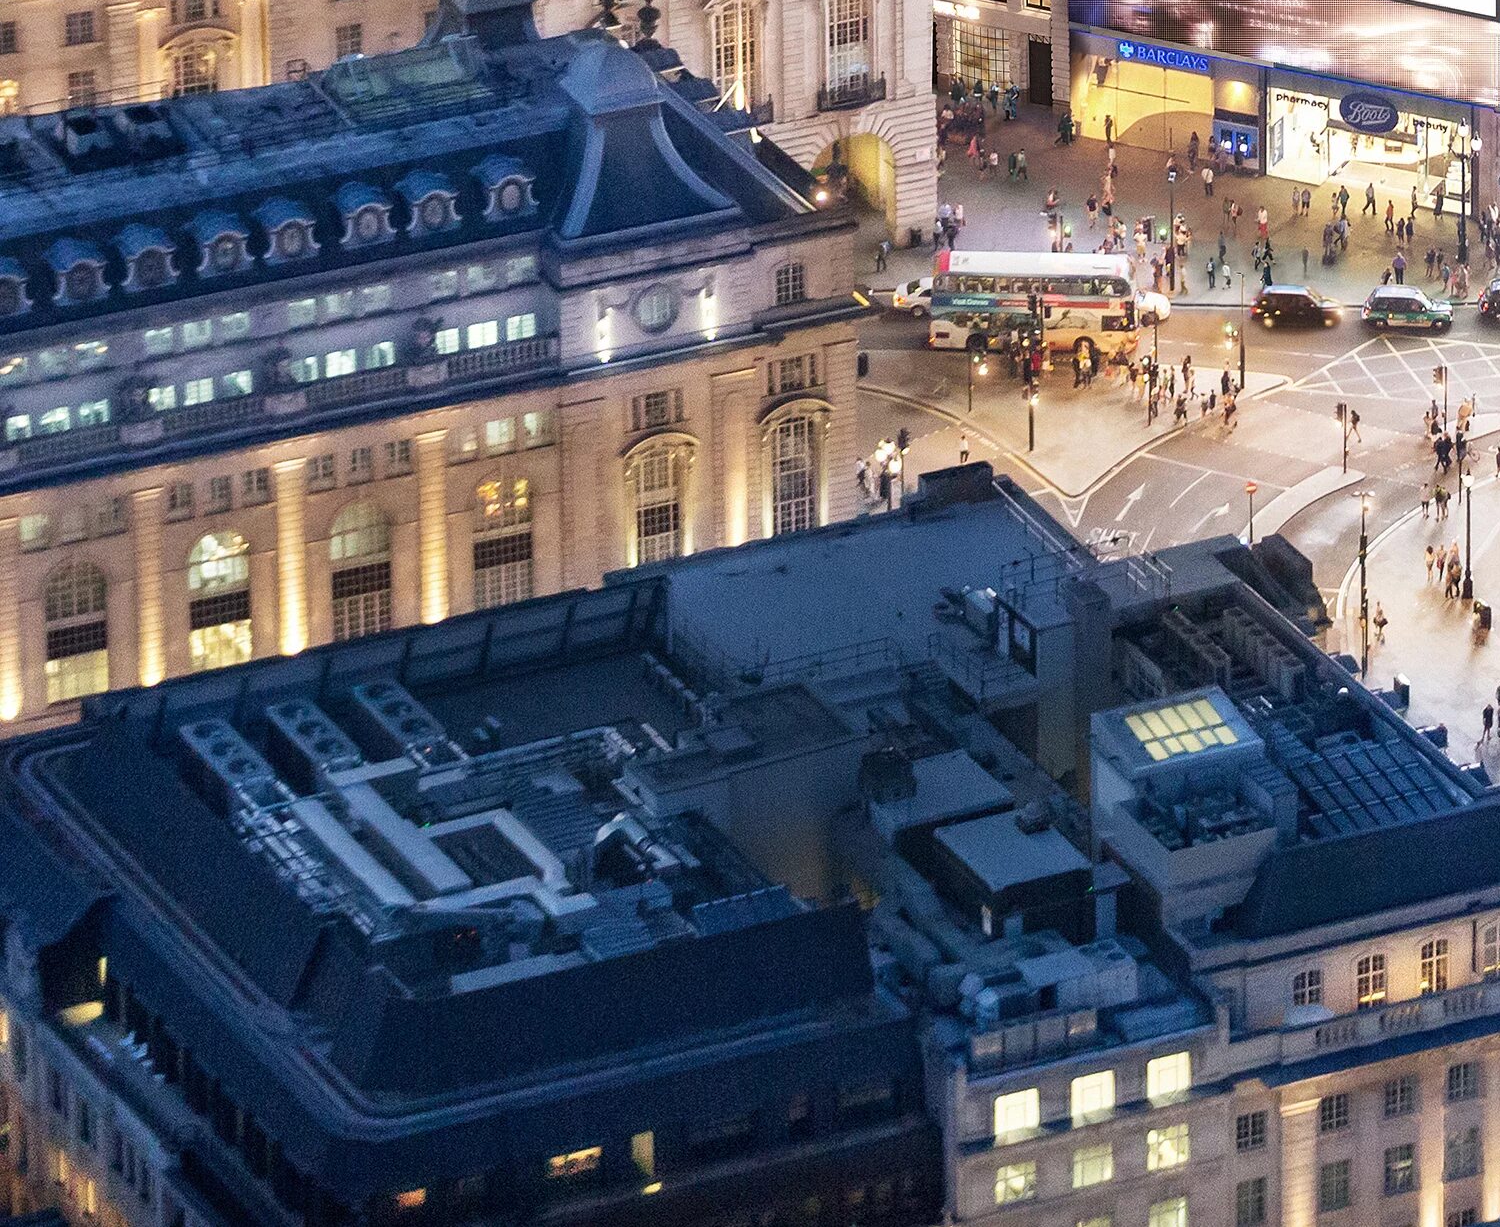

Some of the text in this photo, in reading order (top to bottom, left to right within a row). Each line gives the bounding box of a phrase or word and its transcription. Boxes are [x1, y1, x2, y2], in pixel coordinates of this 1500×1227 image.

[1136, 45, 1209, 72] BARCLAYS
[1275, 92, 1329, 112] pharmacy
[1347, 100, 1391, 126] Boots
[1412, 118, 1449, 134] beauty
